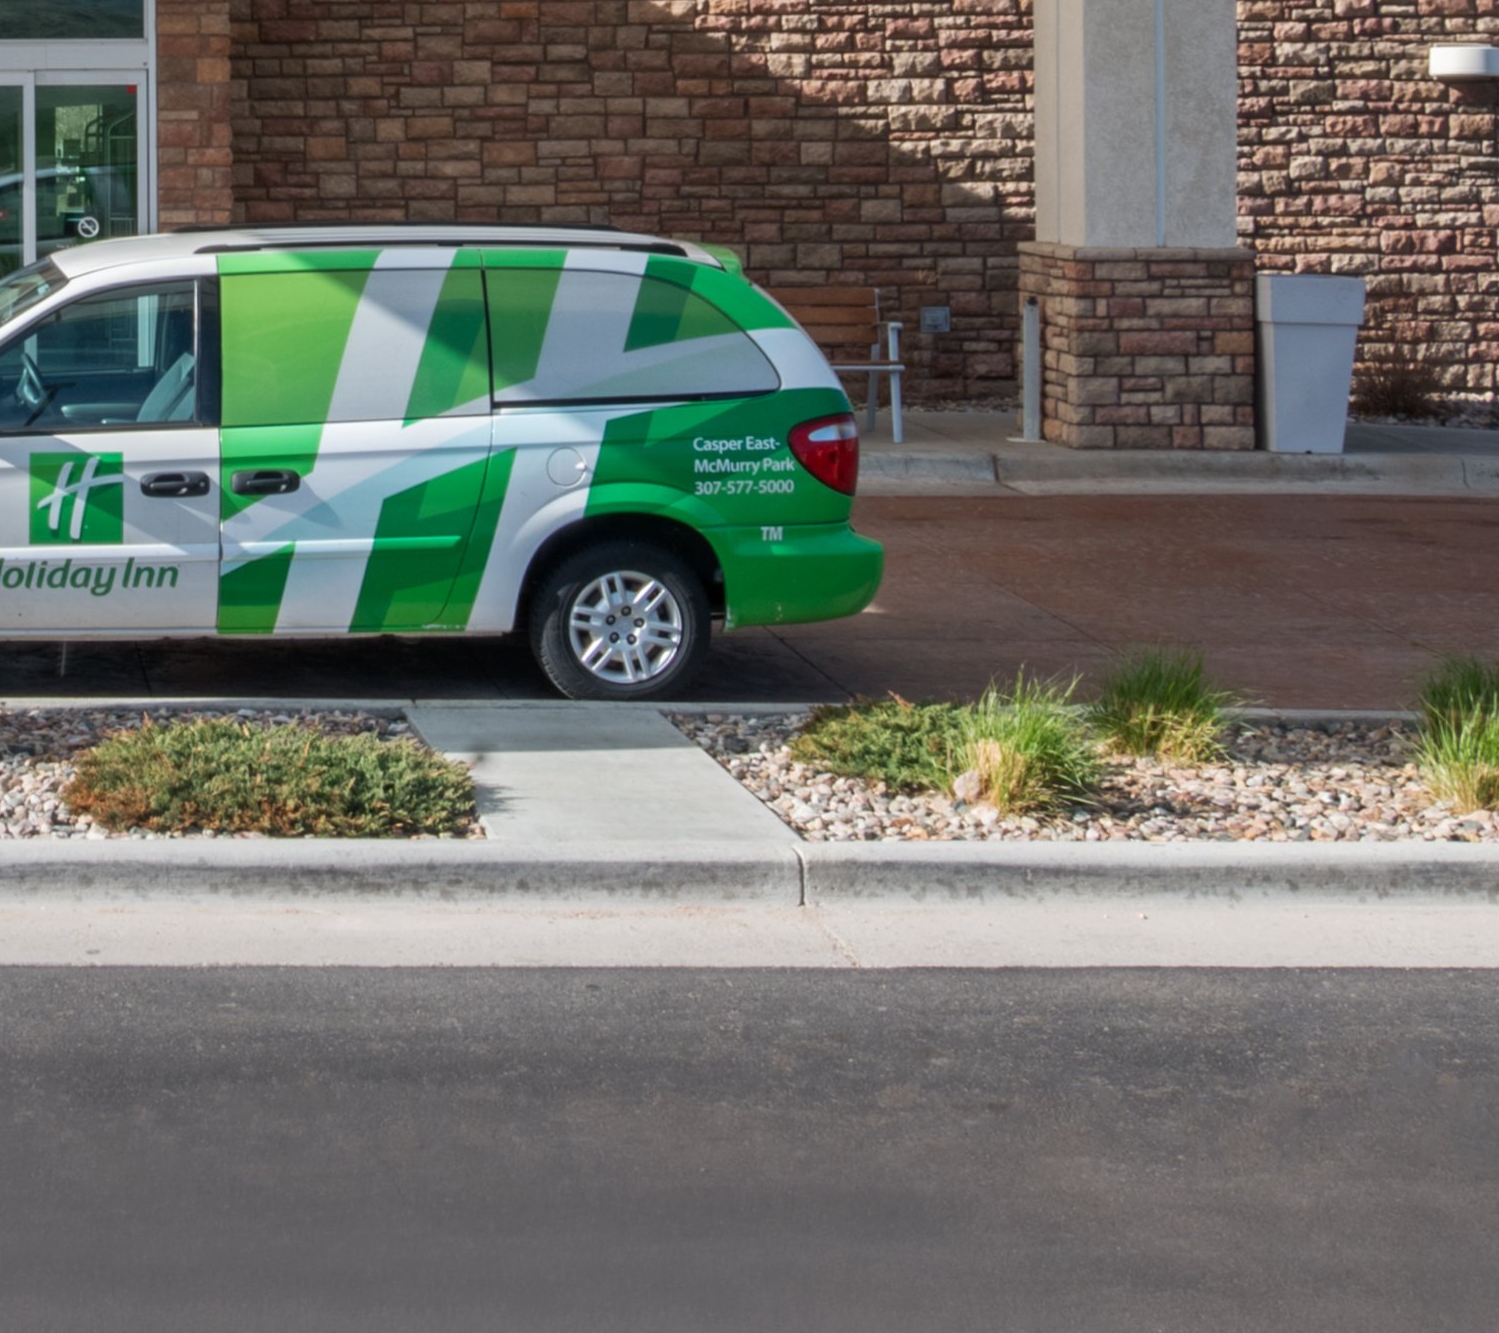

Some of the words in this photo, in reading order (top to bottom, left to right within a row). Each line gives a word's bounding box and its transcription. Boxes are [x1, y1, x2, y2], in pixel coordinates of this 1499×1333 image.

[693, 436, 743, 454] Casper
[745, 436, 781, 450] East-
[694, 458, 760, 475] McMurry
[762, 457, 795, 472] Park
[694, 480, 795, 495] 307-577-5000
[760, 526, 783, 541] TM
[122, 557, 179, 588] Inn
